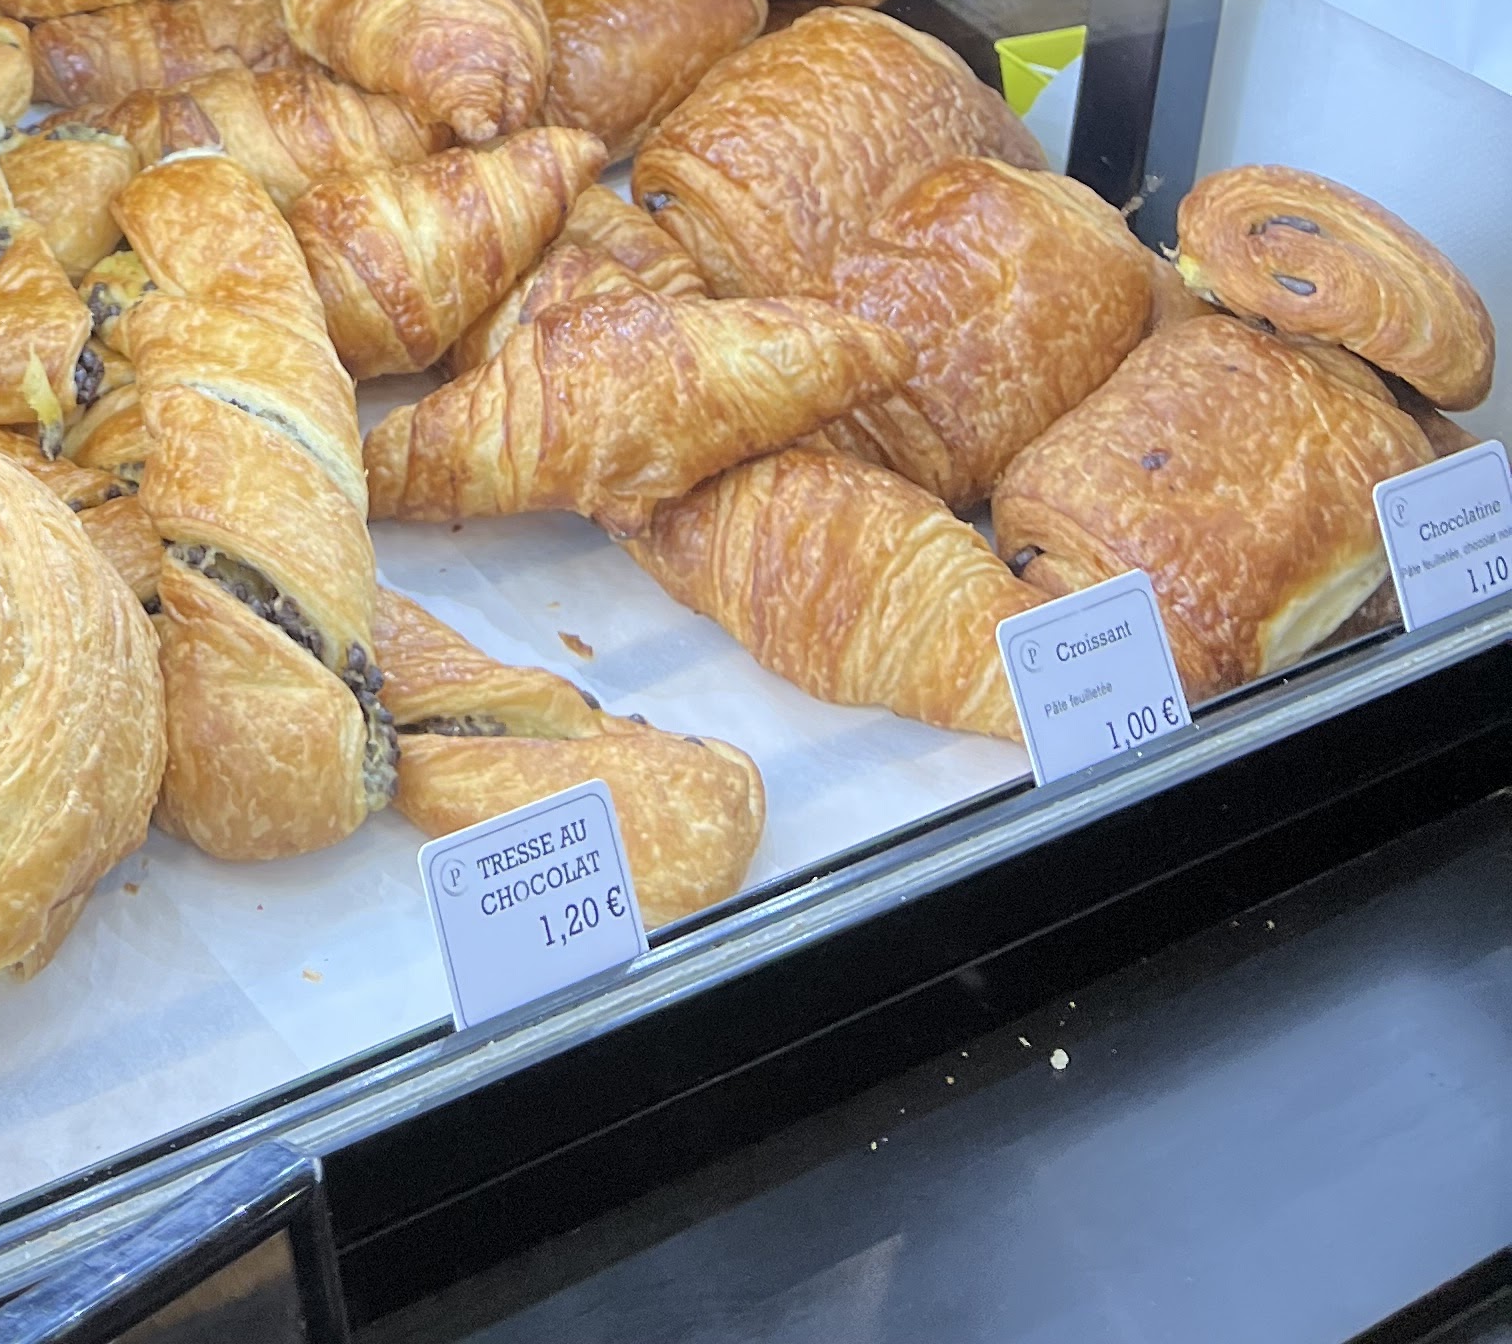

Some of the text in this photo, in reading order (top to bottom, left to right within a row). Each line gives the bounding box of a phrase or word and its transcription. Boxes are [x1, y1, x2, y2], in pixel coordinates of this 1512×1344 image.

[1467, 556, 1508, 594] 1,10
[1028, 649, 1037, 664] P
[1056, 620, 1132, 662] Croissant
[1106, 696, 1179, 750] 1,00 €
[477, 819, 587, 879] TRESSE AU
[450, 868, 460, 887] P
[481, 851, 600, 915] CHOCOLAT
[540, 885, 625, 946] 1,20 €
